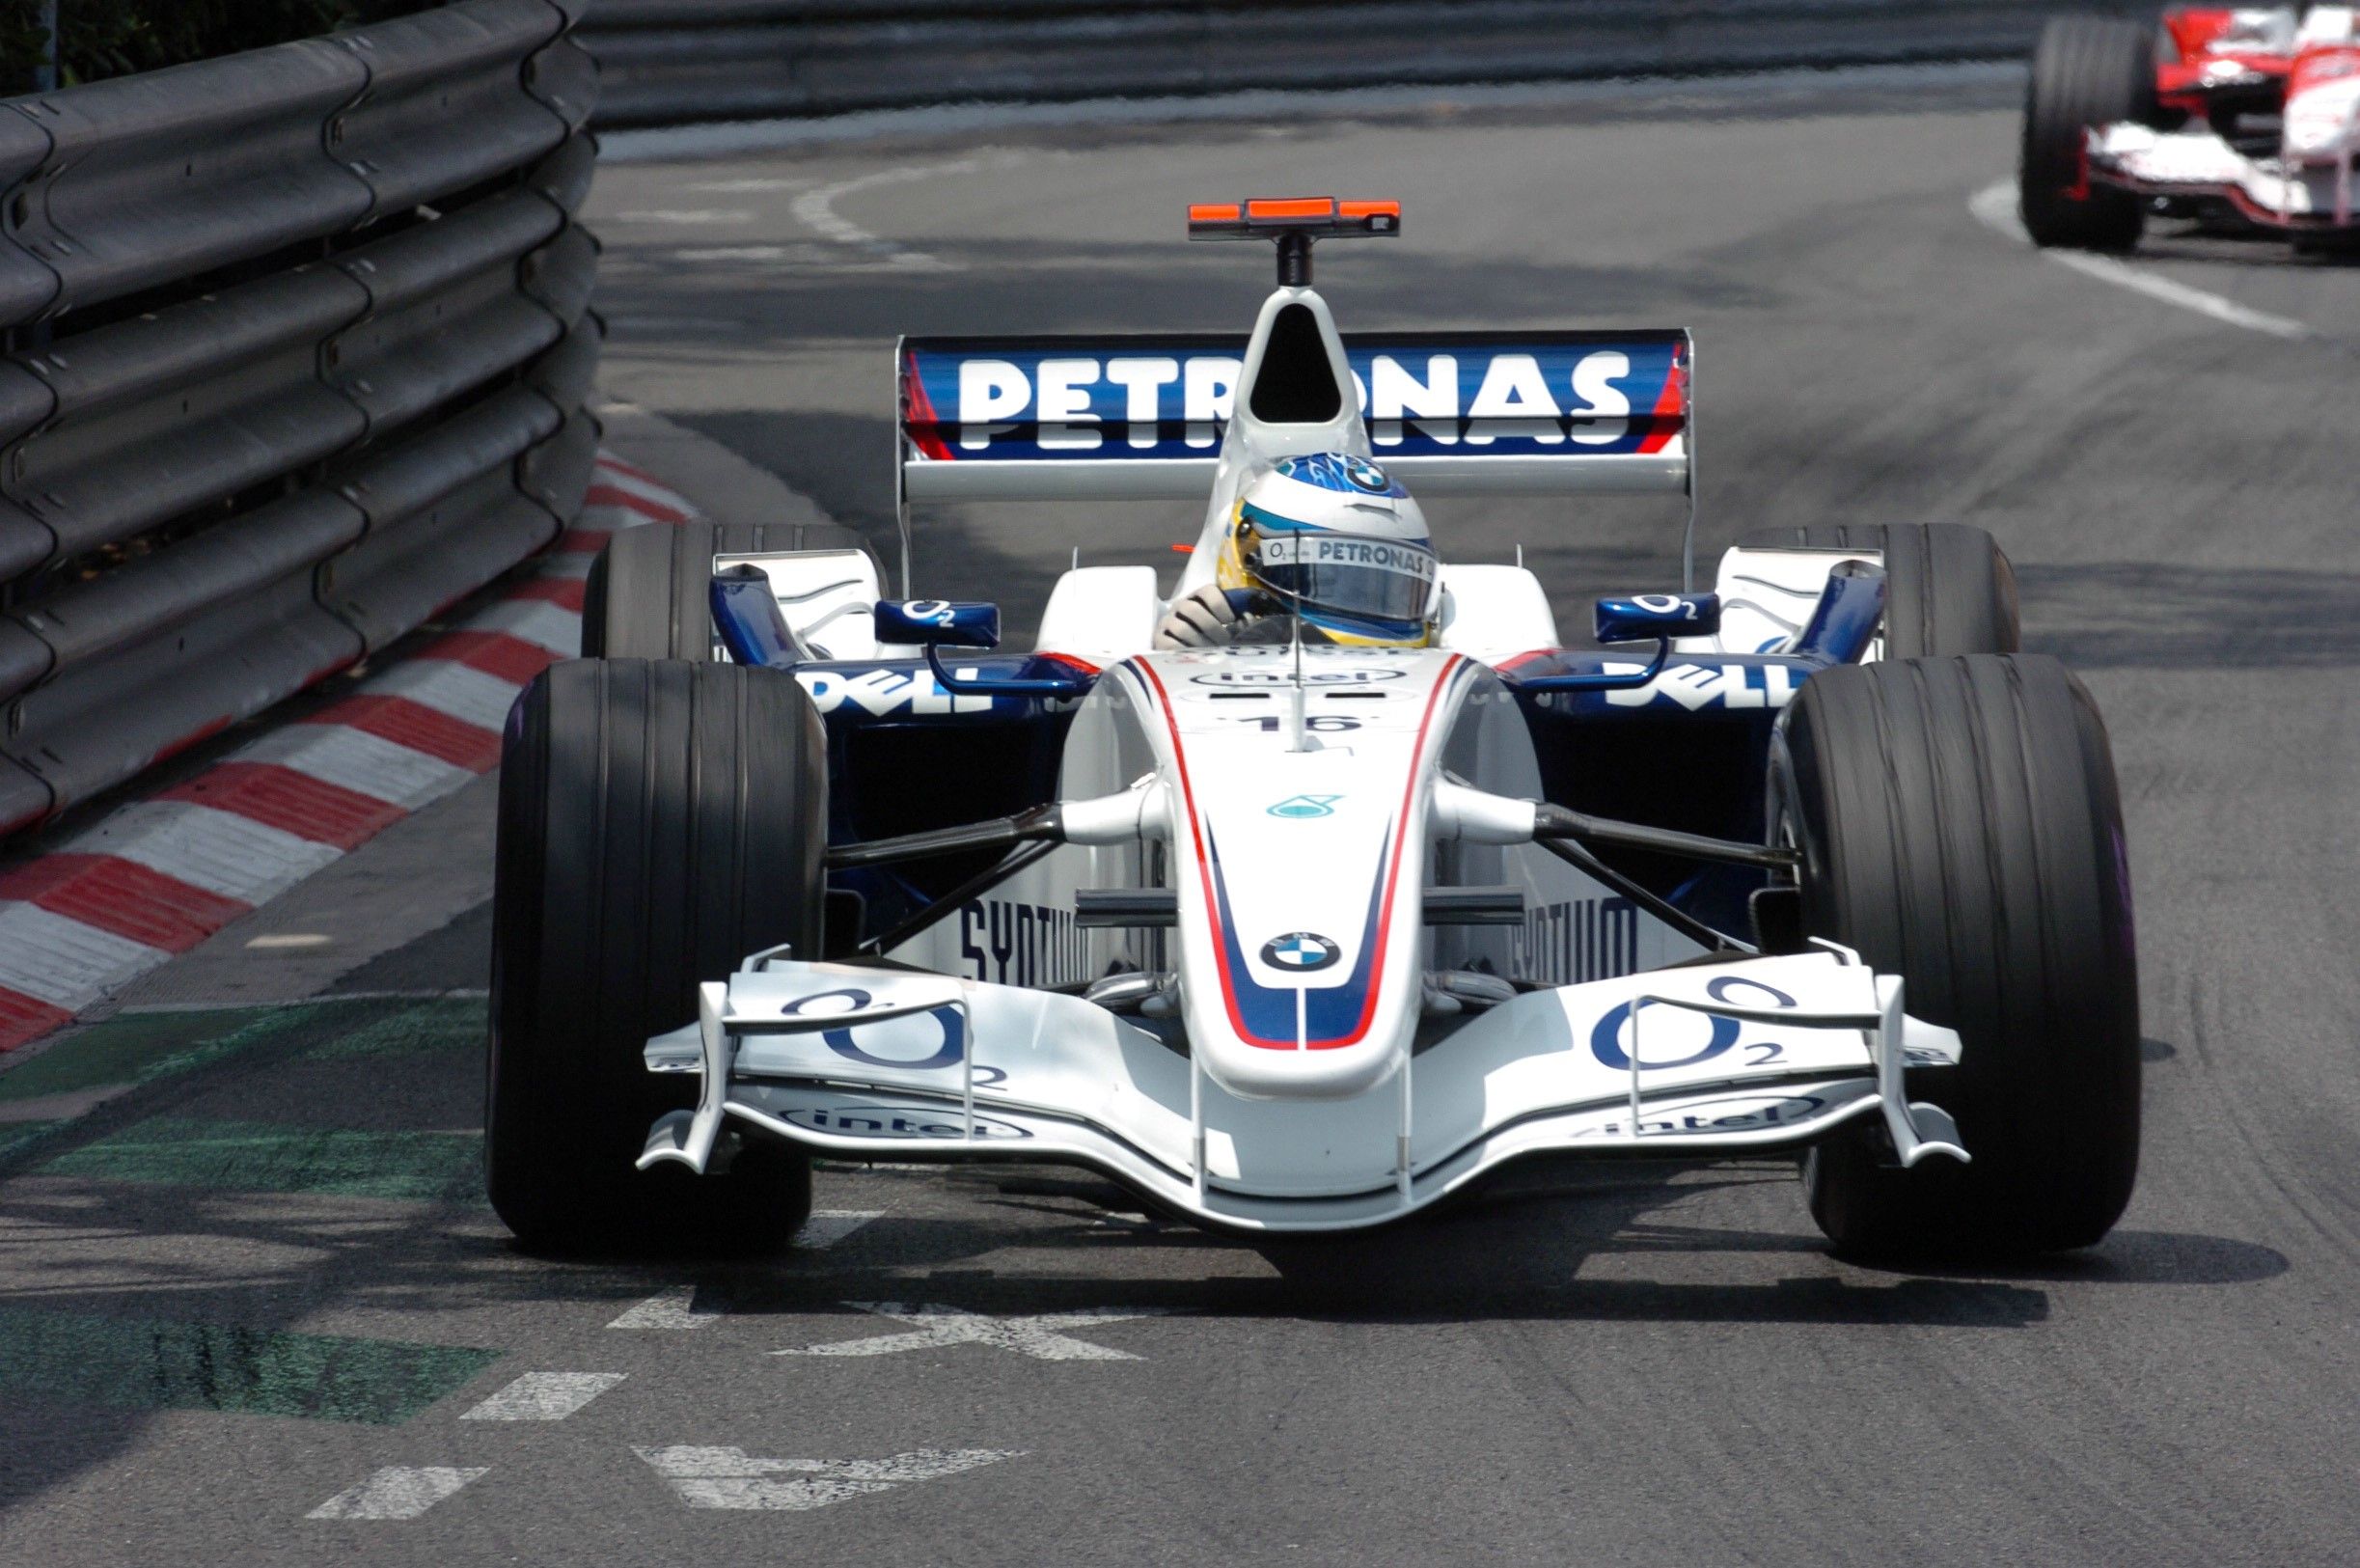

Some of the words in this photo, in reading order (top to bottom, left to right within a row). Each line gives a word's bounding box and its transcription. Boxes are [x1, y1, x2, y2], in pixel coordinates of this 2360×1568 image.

[959, 351, 1630, 450] PETRNAS
[1318, 541, 1423, 574] PETRONAS
[902, 598, 954, 627] O2
[1632, 594, 1698, 620] O2
[794, 667, 993, 717] DELL
[1602, 662, 1799, 711] DELL
[1237, 715, 1362, 732] 16
[1590, 999, 1789, 1071] O2
[1605, 1106, 1779, 1134] intel
